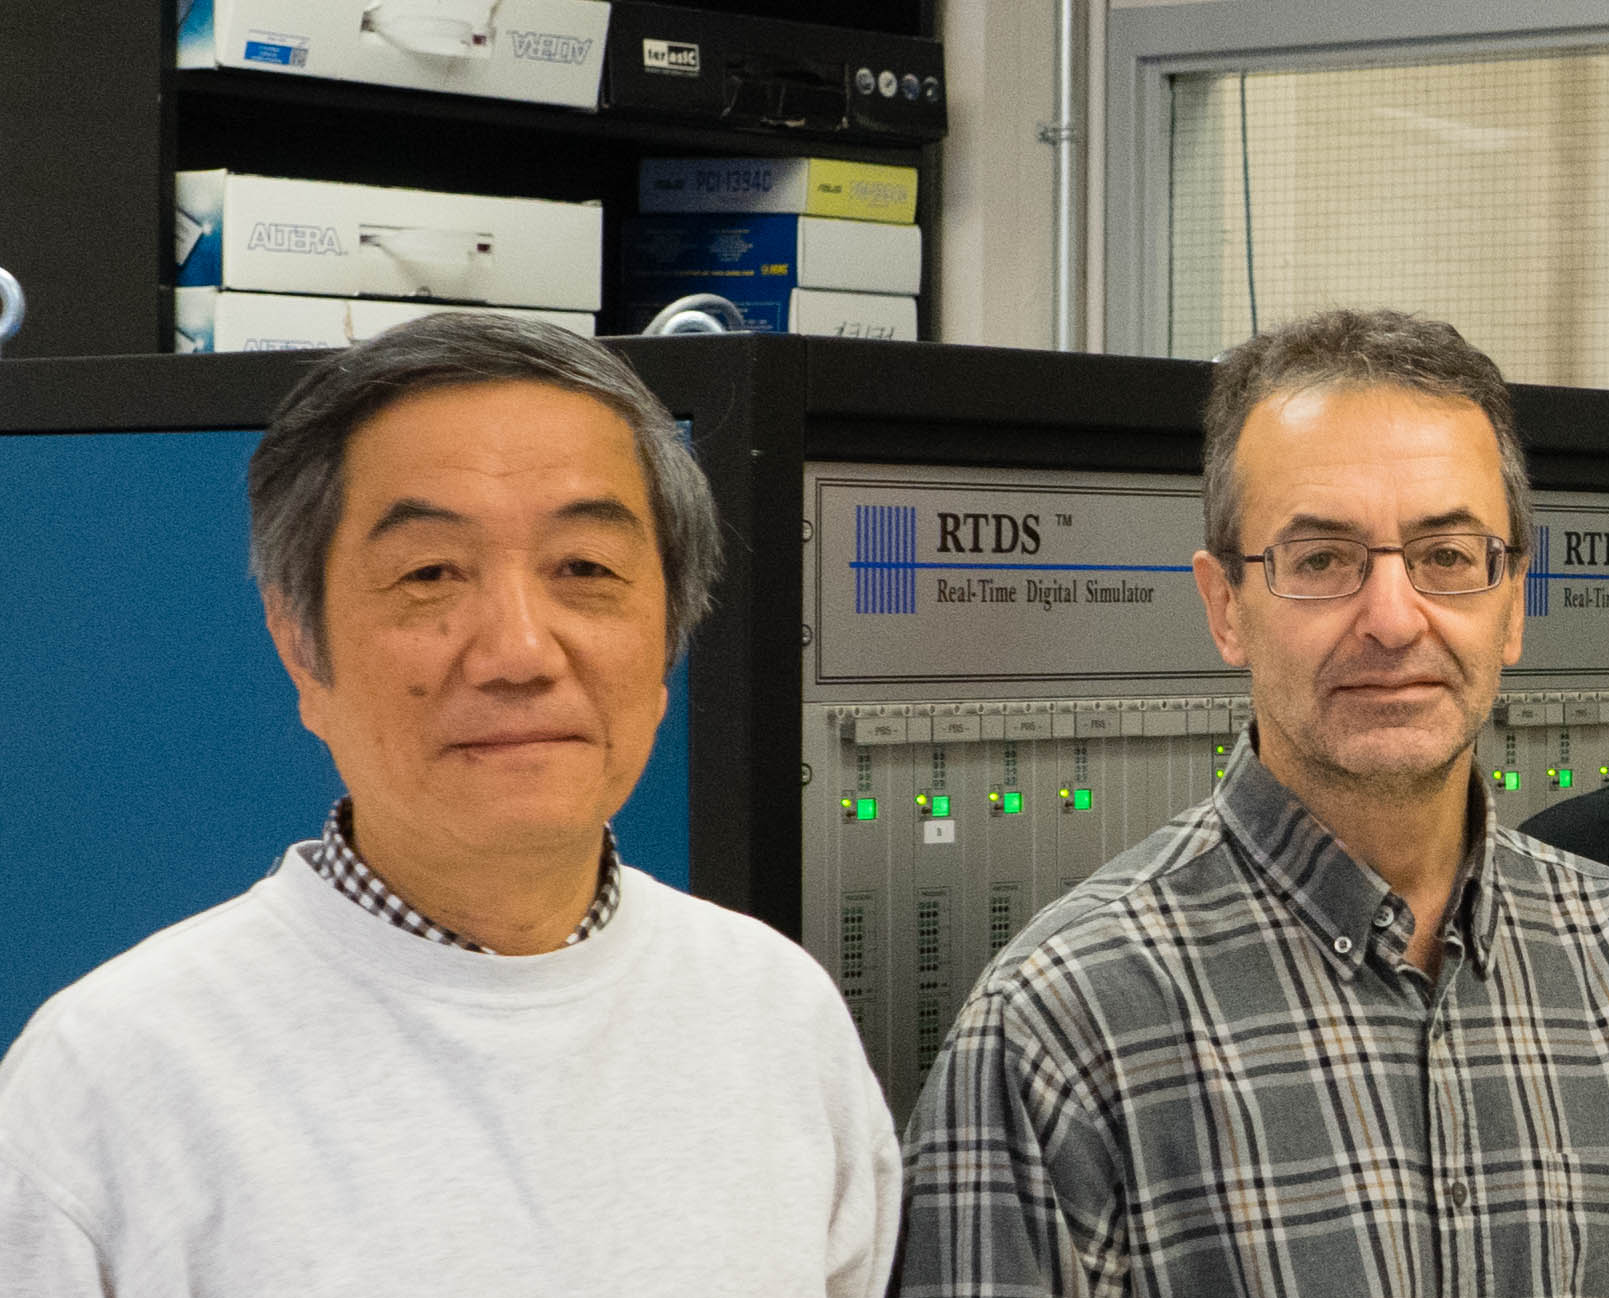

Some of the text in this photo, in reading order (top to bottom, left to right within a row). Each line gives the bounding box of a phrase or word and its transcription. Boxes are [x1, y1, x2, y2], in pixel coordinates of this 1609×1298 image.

[510, 30, 593, 64] ALTERA
[247, 222, 342, 256] ALTERA
[936, 512, 1073, 555] RTDS TM
[936, 578, 1154, 611] Real-Time Digital Simulator
